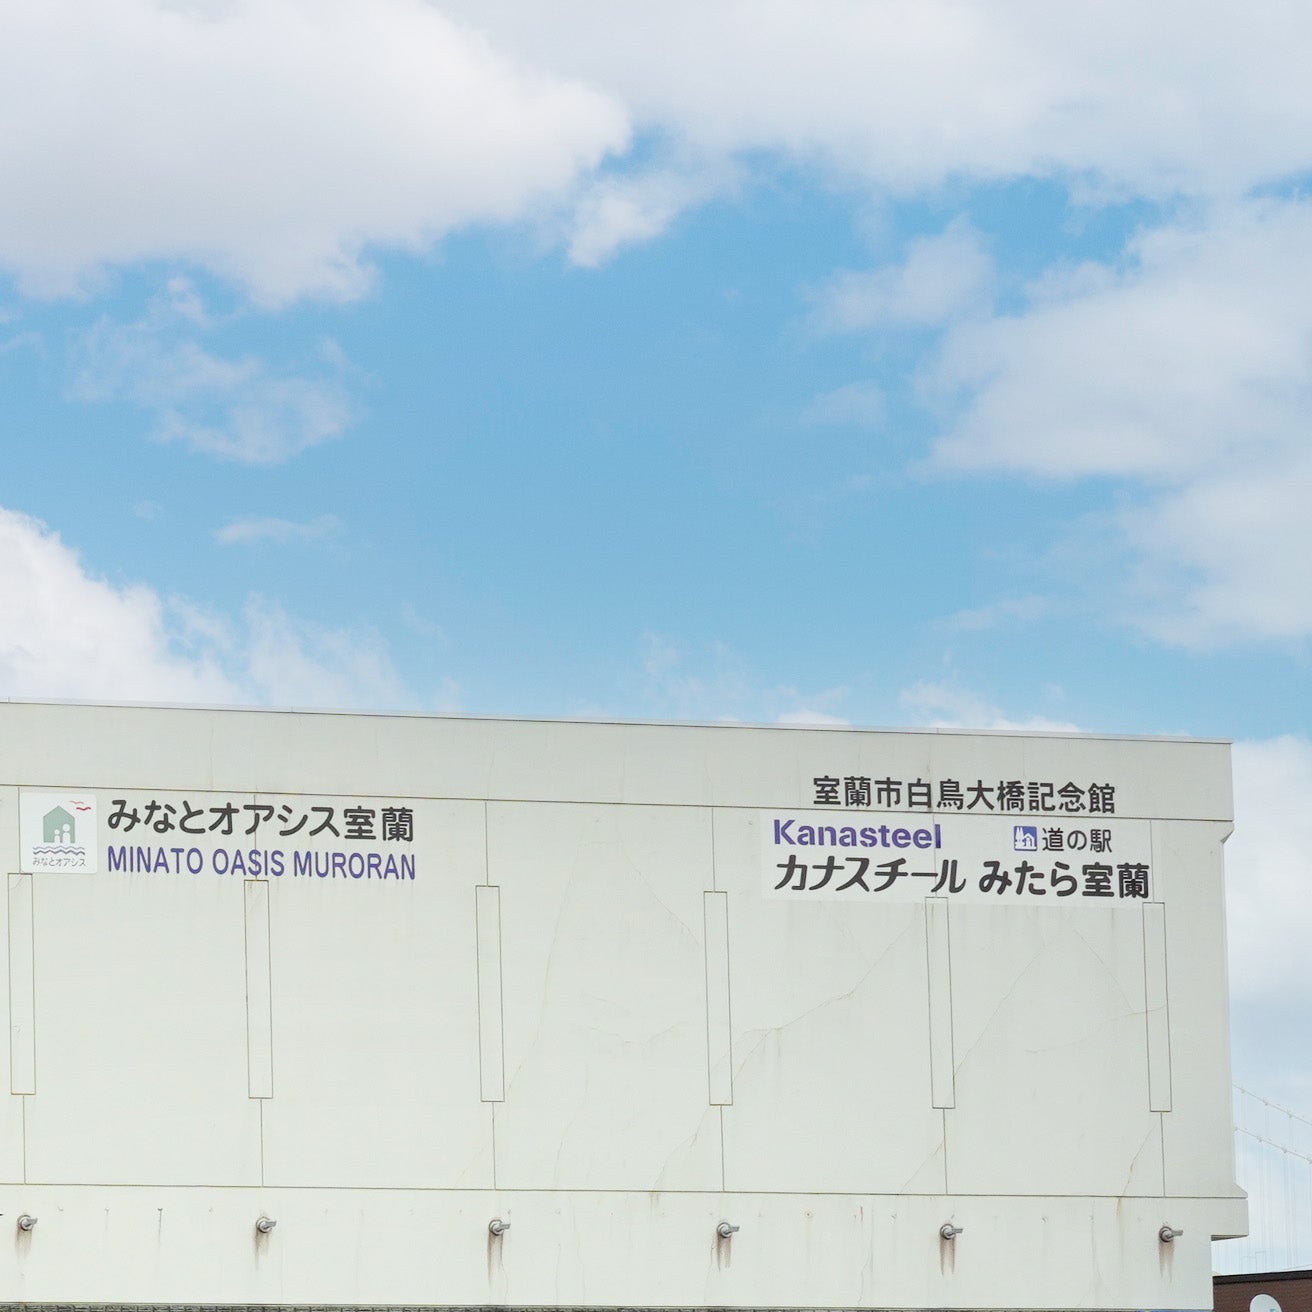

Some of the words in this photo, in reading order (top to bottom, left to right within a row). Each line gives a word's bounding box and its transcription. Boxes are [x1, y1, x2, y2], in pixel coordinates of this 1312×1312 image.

[812, 775, 1117, 815] 室蘭市白鳥大橋記念館
[107, 798, 415, 843] みなとオアシス室蘭
[773, 818, 942, 850] Kanasteel
[1041, 826, 1114, 854] 道の駅
[32, 856, 87, 868] みなとオアシス
[107, 845, 204, 876] MINATO
[212, 847, 285, 878] OASIS
[293, 849, 416, 881] MURORAN
[773, 853, 967, 894] カナスチール
[978, 859, 1151, 899] みたら室蘭
